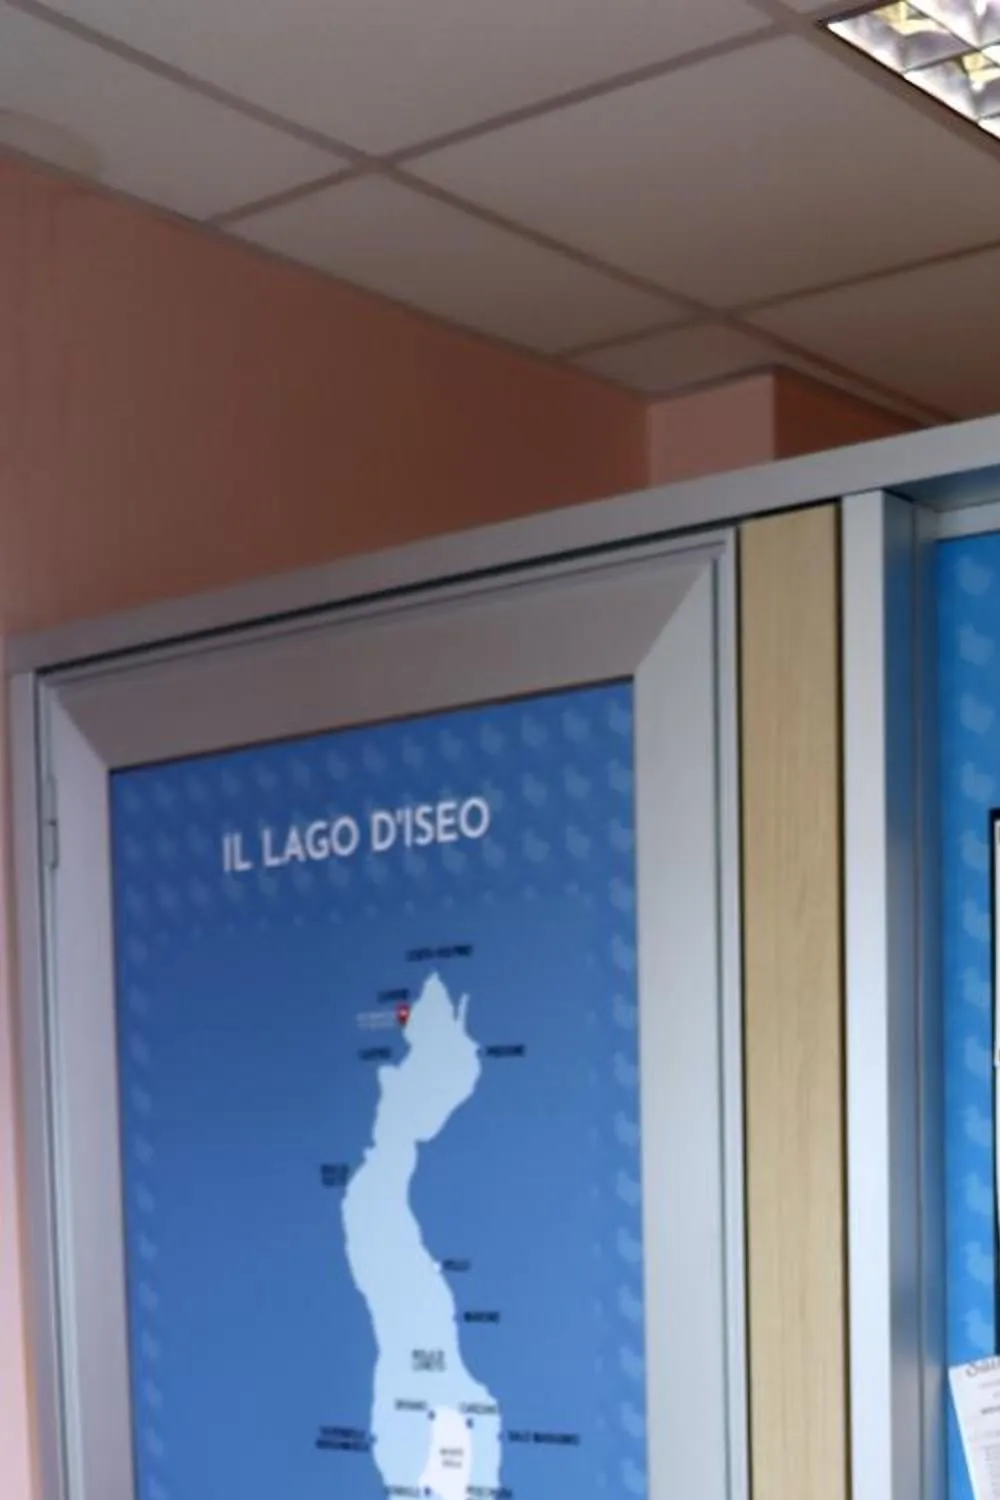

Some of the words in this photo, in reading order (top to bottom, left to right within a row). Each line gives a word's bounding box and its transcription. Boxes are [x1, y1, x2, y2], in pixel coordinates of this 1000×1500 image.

[222, 831, 252, 872] IL
[261, 815, 360, 867] LAGO
[371, 796, 490, 852] D'ISEO
